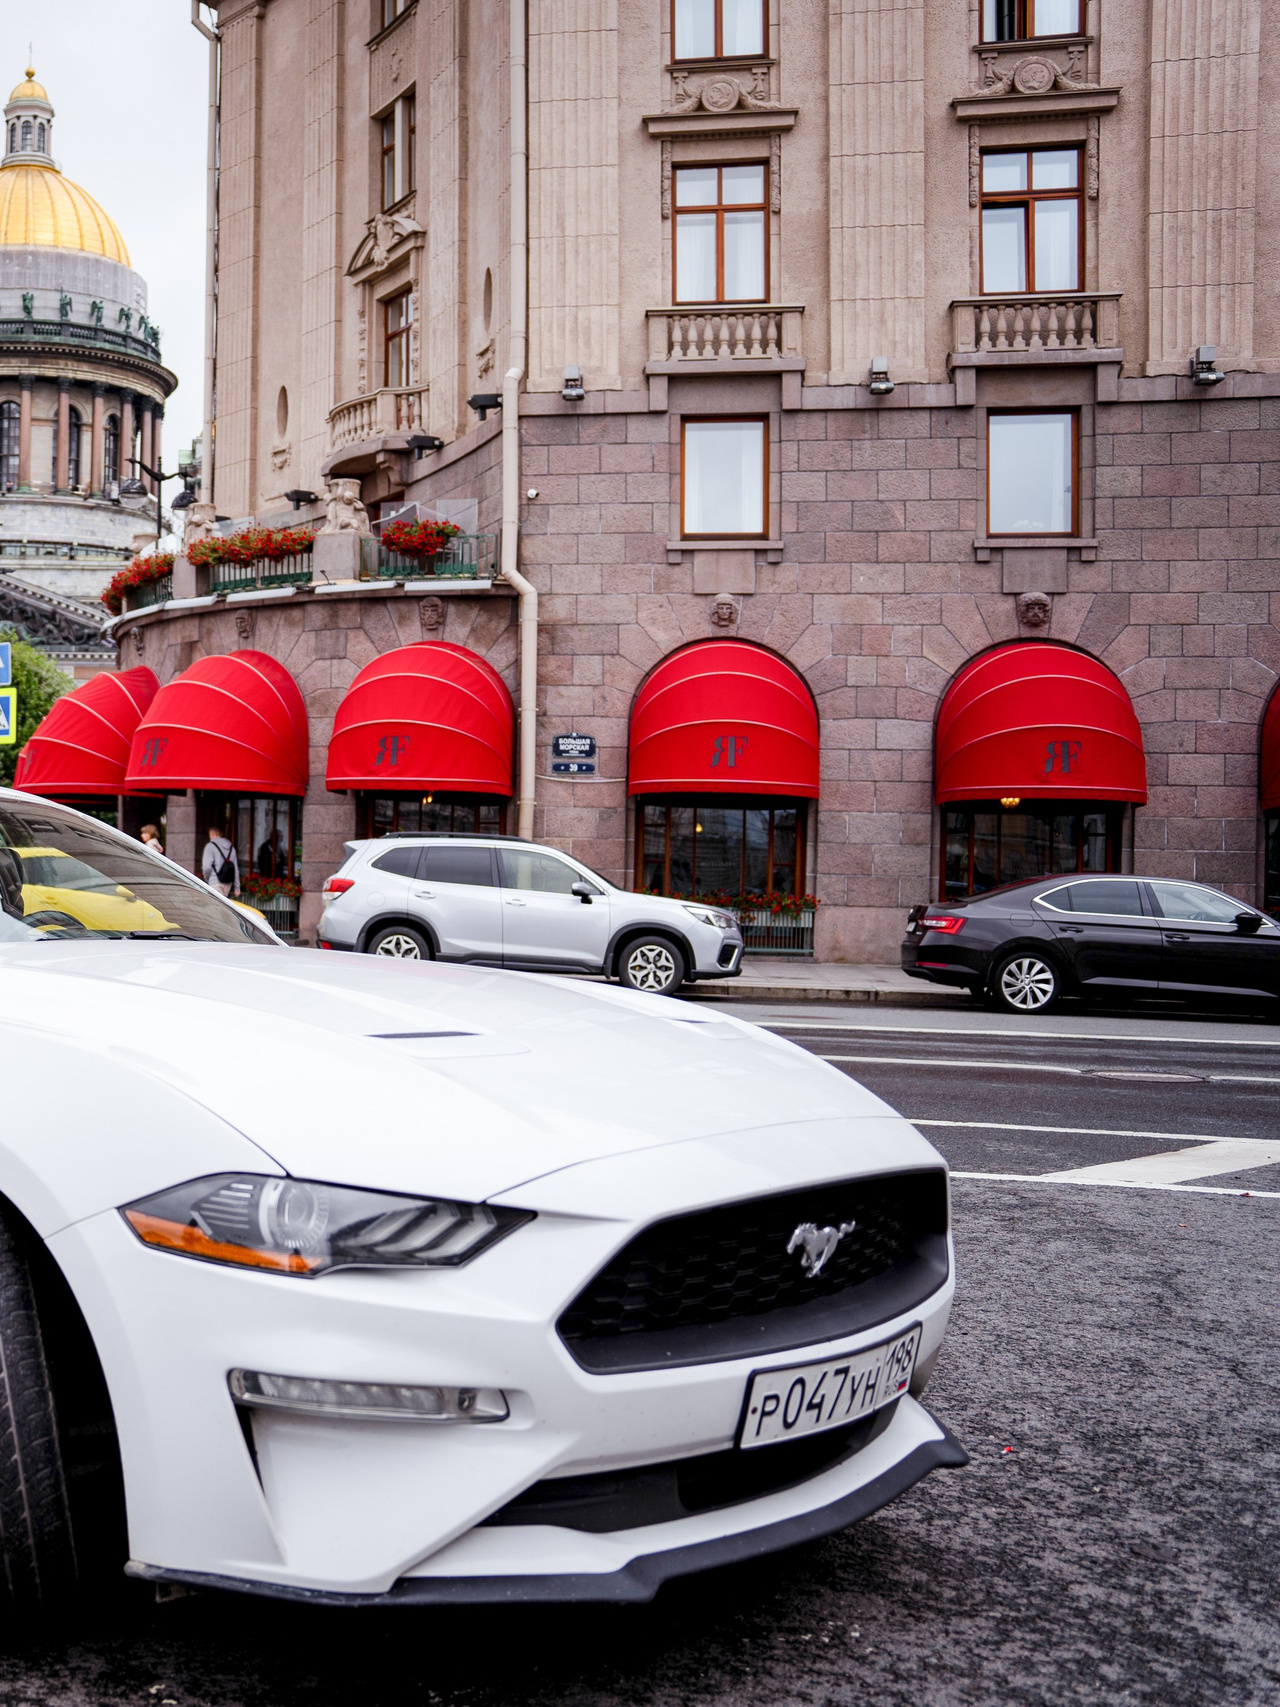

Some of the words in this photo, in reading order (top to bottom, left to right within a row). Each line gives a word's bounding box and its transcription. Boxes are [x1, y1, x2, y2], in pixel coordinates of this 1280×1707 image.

[558, 737, 591, 745] БОЛЬШАЯ
[569, 763, 578, 772] 39
[886, 1335, 915, 1383] 198
